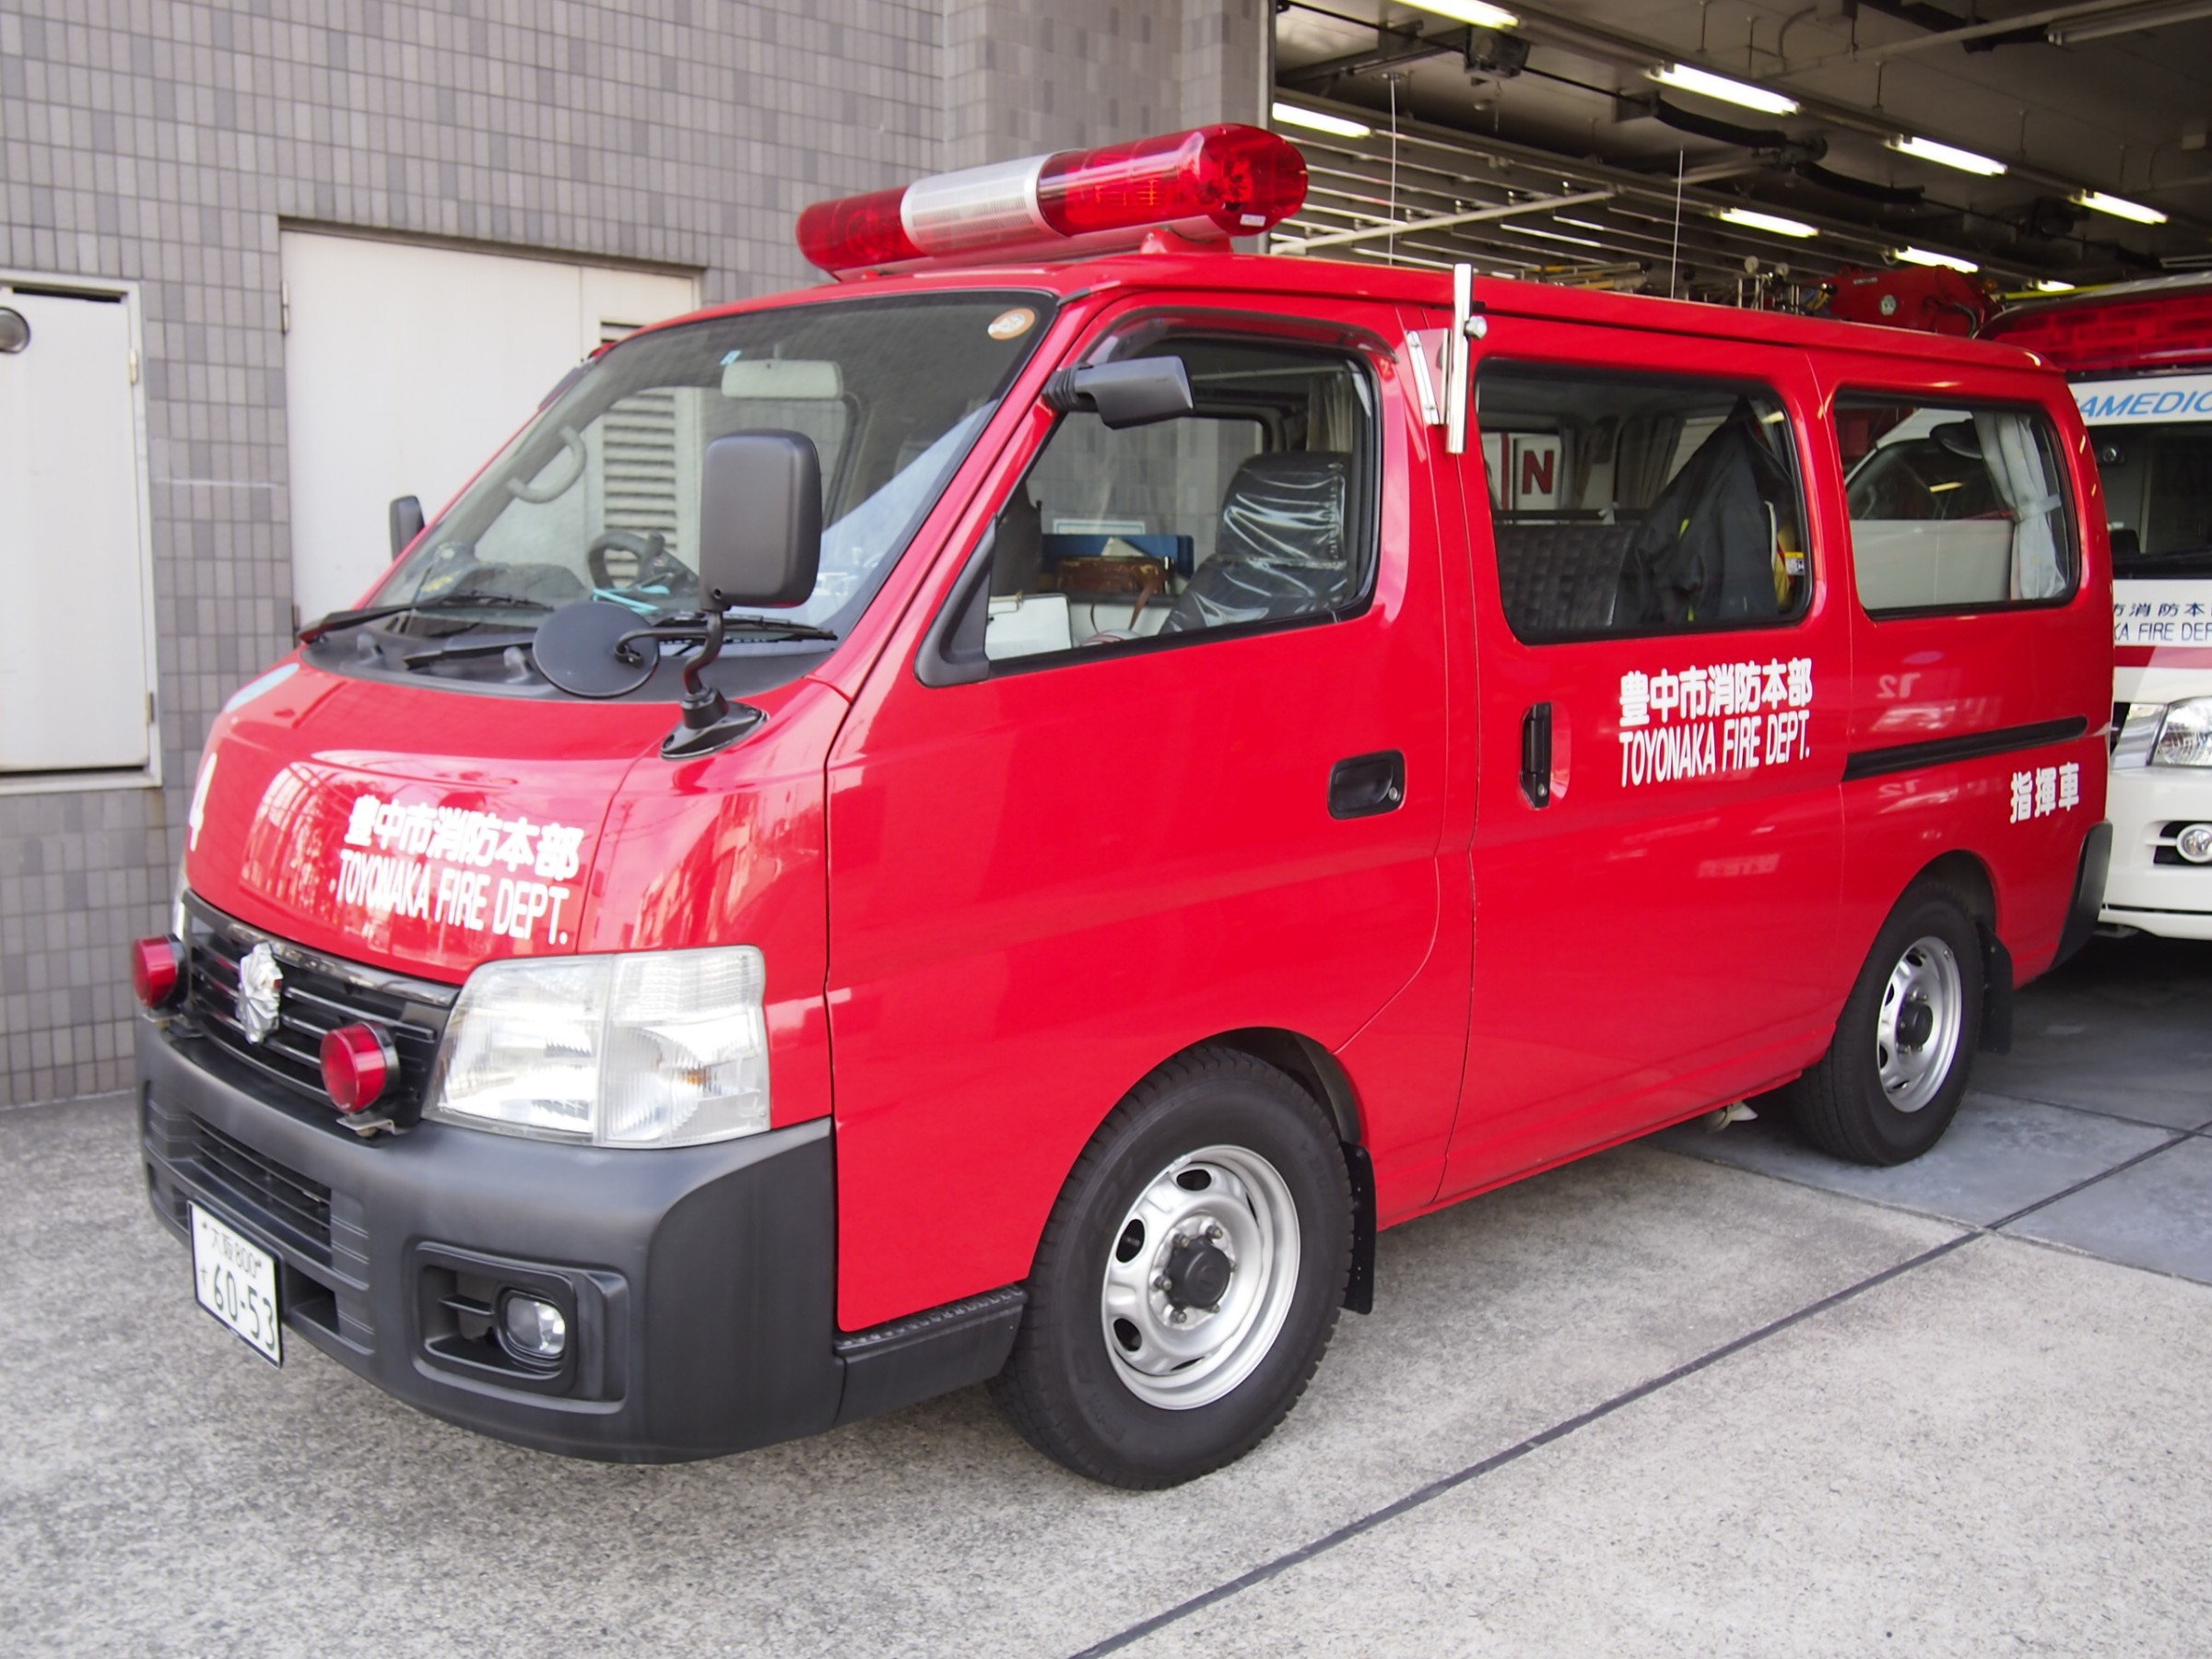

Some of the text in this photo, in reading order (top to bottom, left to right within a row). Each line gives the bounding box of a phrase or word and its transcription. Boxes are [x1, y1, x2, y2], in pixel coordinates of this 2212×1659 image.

[2076, 390, 2212, 418] AMEDIC
[1523, 450, 1555, 495] N
[2113, 602, 2212, 618] 消防本
[2138, 622, 2175, 641] FIRE
[1619, 657, 1813, 726] 豊中市消防本部
[1619, 710, 1810, 788] TOYONAKA FIRE DEPT.
[2010, 761, 2079, 824] 指揮車
[344, 794, 585, 881] 豊中市消防本部
[336, 849, 571, 946] TOYONAKA FIRE DEPT.
[214, 1264, 276, 1351] 60-53
